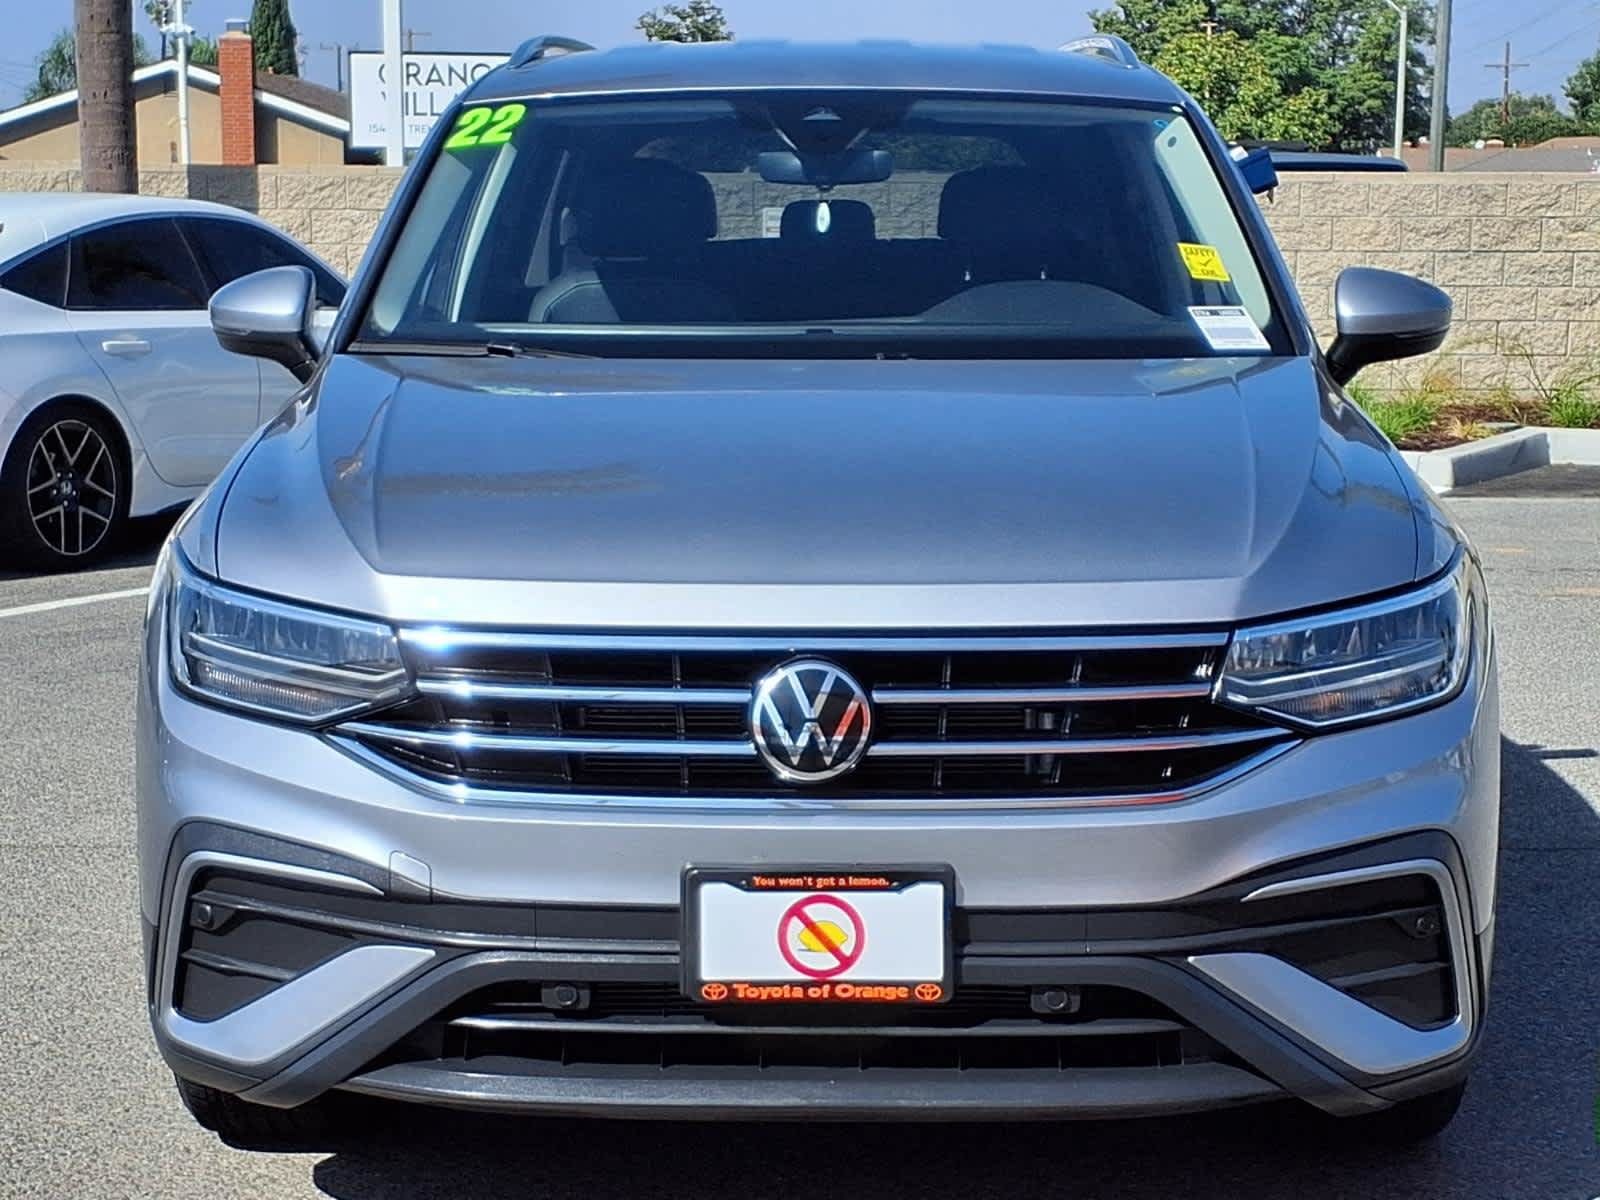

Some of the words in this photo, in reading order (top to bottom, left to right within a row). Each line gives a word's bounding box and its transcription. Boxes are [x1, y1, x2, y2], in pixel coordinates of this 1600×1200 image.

[378, 62, 490, 86] RAN
[444, 103, 527, 148] 22
[752, 876, 776, 886] You
[732, 983, 804, 999] Toyota
[807, 983, 830, 999] of
[834, 983, 909, 1000] Orange
